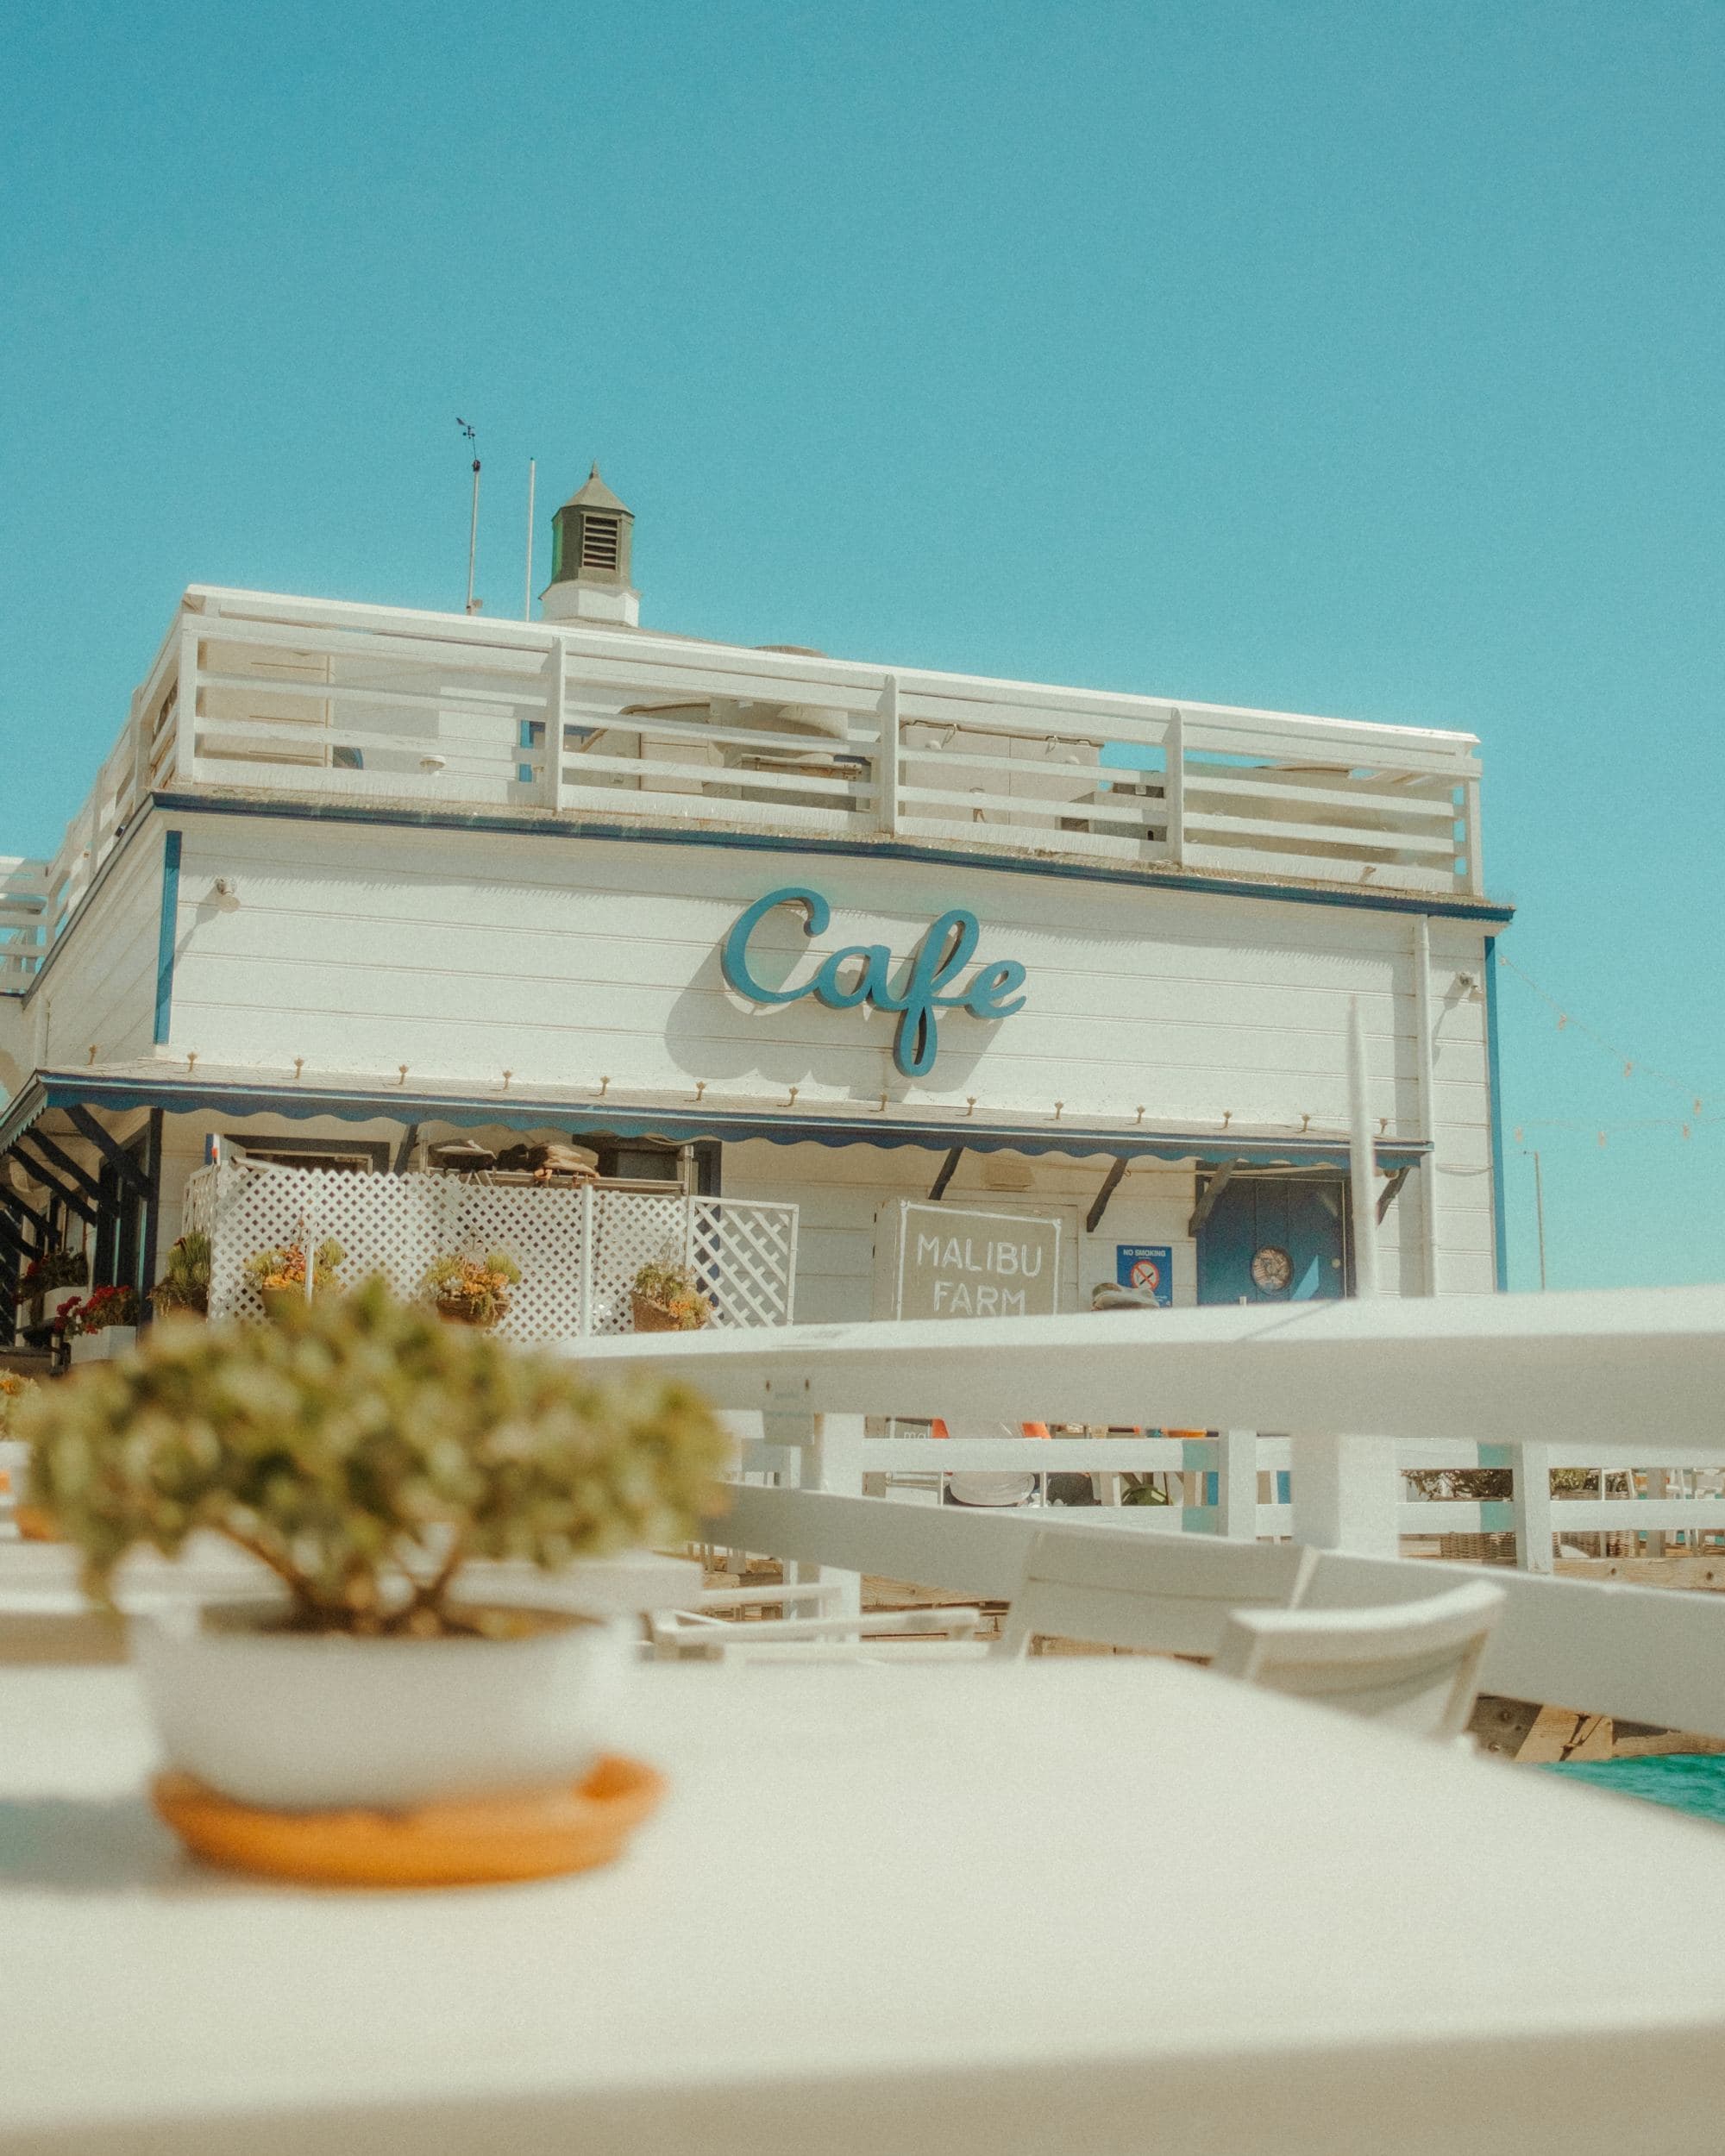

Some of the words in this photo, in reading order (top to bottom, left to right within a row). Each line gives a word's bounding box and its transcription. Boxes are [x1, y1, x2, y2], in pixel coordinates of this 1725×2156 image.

[721, 887, 1027, 1077] Cafe
[917, 1233, 1042, 1277] MALIBU
[933, 1280, 1026, 1317] FARM
